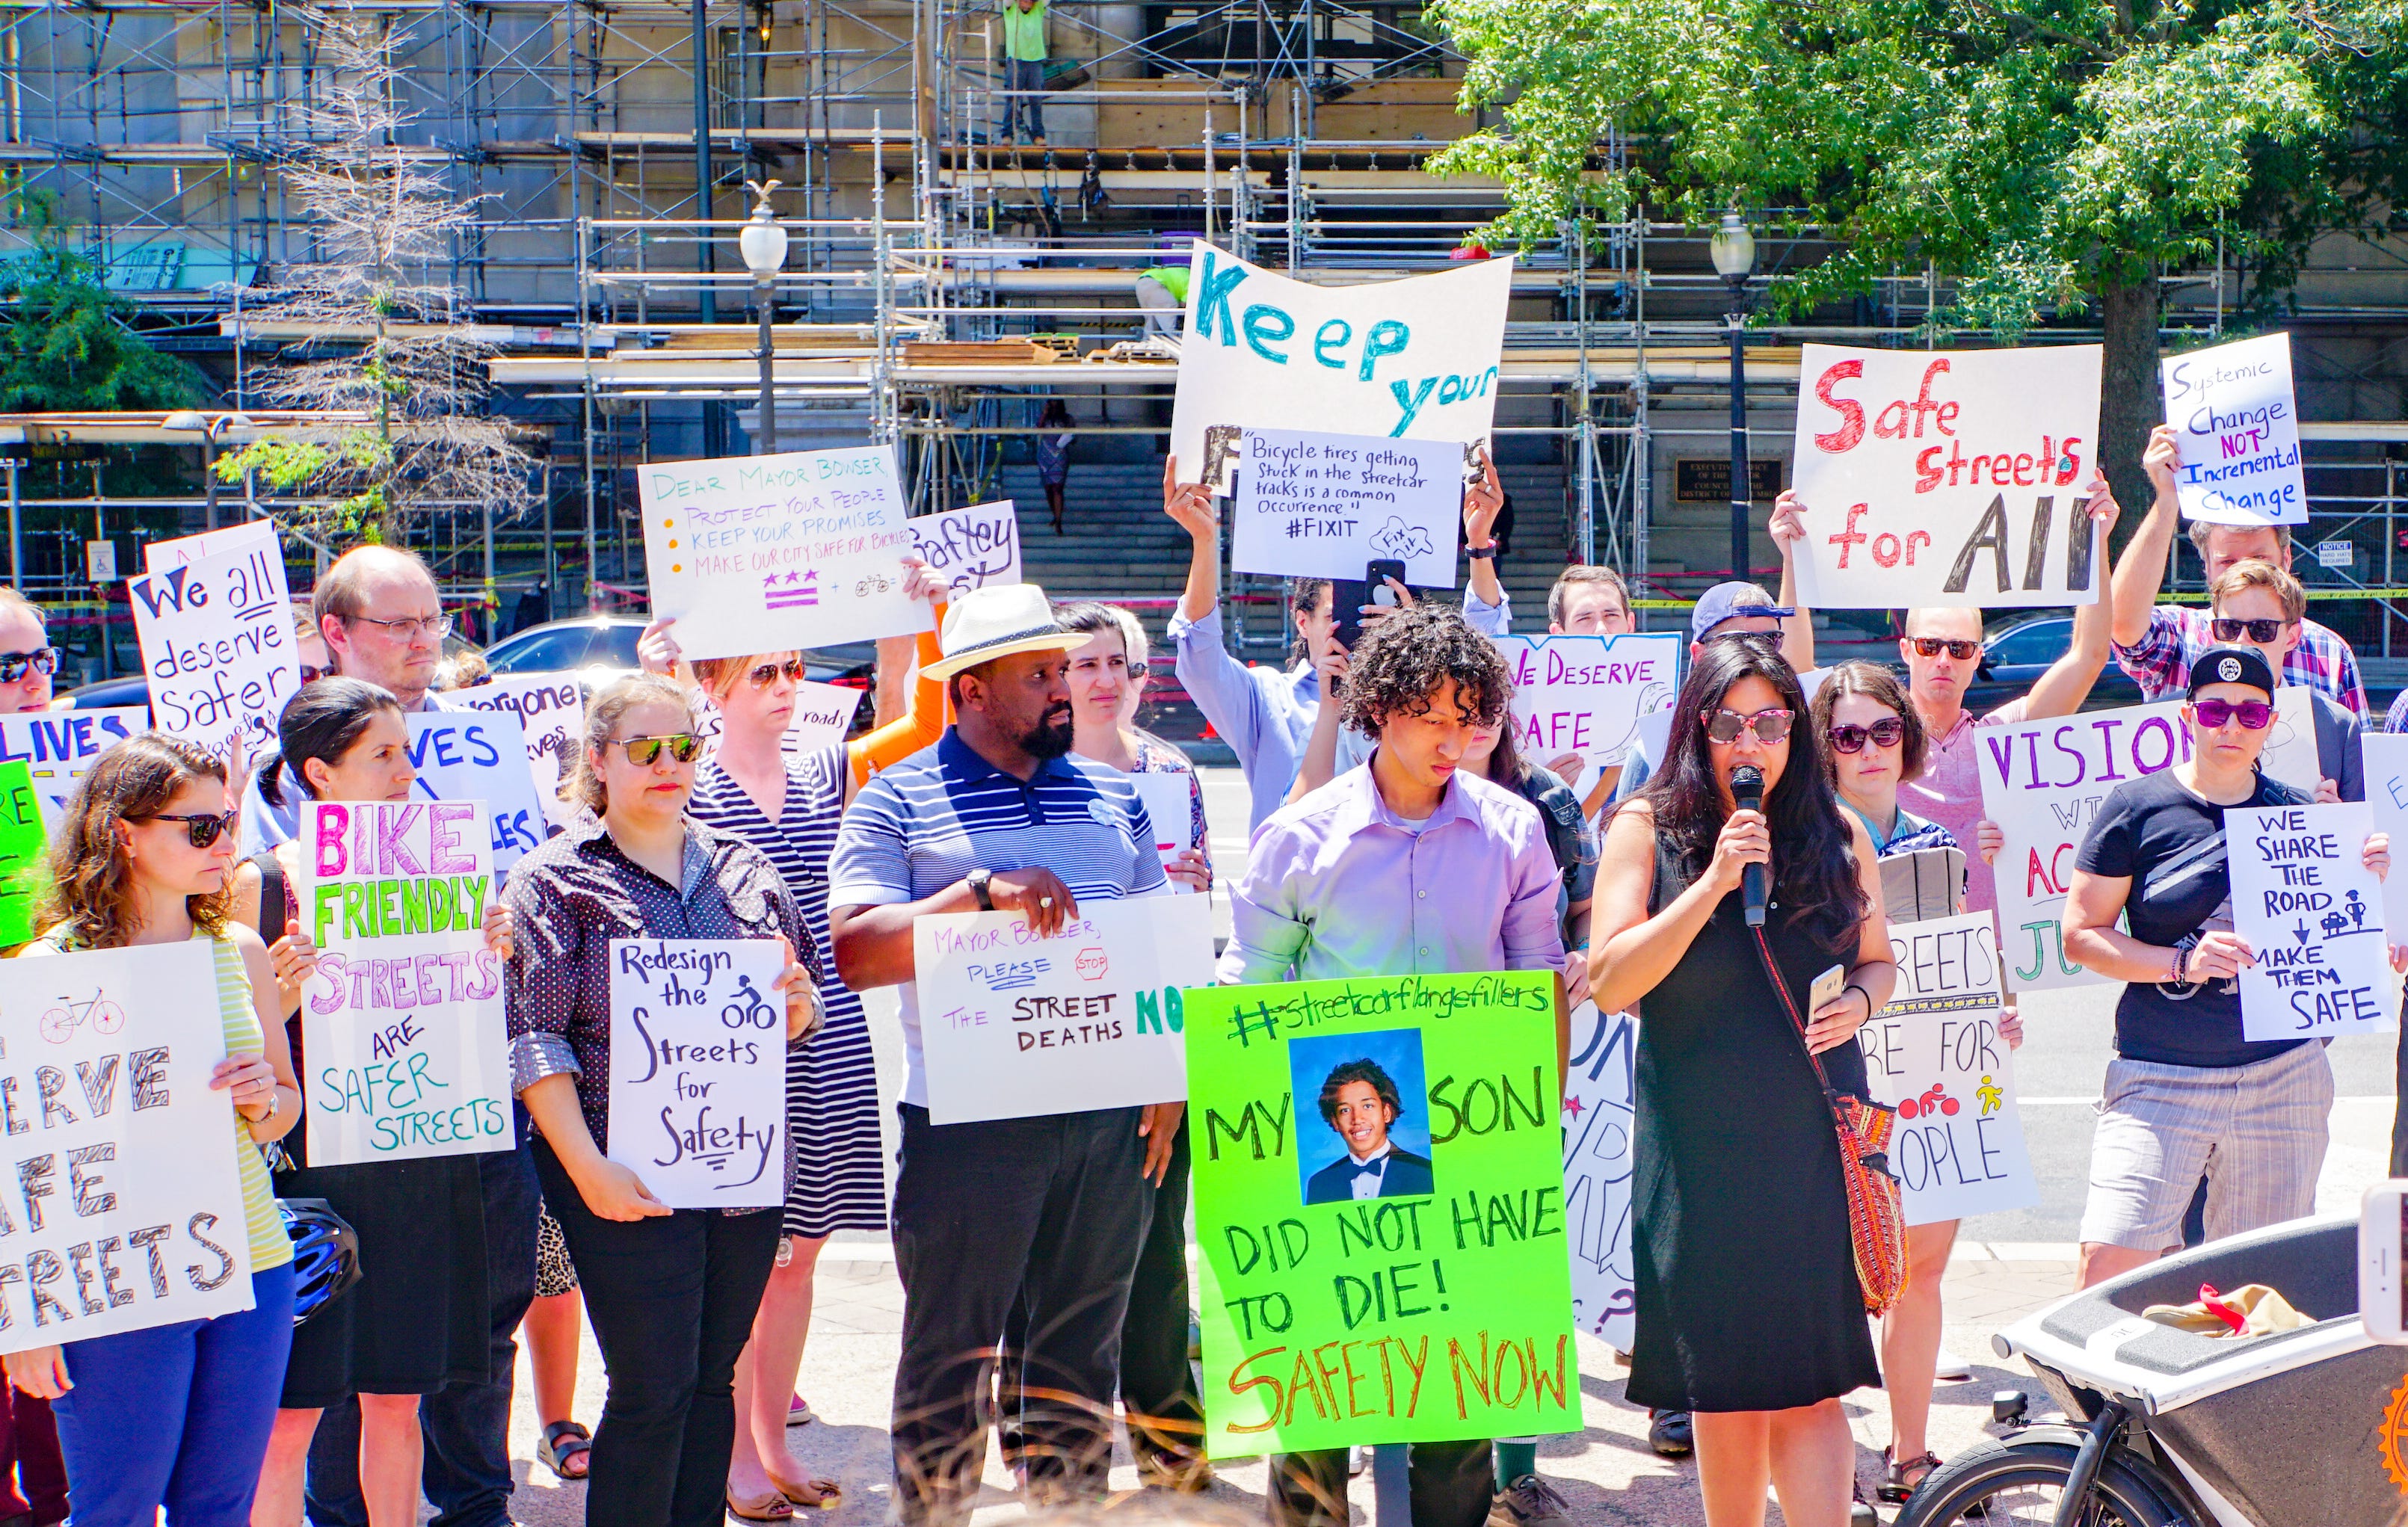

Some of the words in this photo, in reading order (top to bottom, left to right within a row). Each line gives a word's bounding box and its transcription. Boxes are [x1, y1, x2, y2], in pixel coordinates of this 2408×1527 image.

[1196, 251, 1411, 382] Keep
[1389, 365, 1499, 438] your
[2171, 361, 2273, 404] Systemic
[1814, 358, 1960, 454] Safe
[2187, 402, 2288, 439] Change
[1324, 445, 1358, 463] tires
[1366, 450, 1419, 479] getting
[2181, 442, 2300, 484] Incremental
[2220, 428, 2261, 460] NOT
[652, 474, 727, 501] DEAR
[739, 466, 810, 491] MAYOR
[1254, 480, 1298, 498] tracks
[1305, 482, 1316, 498] is
[1322, 487, 1329, 499] a
[1336, 488, 1396, 504] common
[1305, 466, 1318, 478] in
[1324, 463, 1352, 481] the
[683, 505, 777, 528] PROTECT
[783, 496, 825, 514] YOUR
[831, 488, 885, 509] PEOPLE
[1286, 518, 1358, 539] #FIXIT
[692, 527, 745, 550] KEEP
[752, 522, 795, 543] YOUR
[802, 510, 886, 536] PROMISES
[1382, 528, 1405, 548] Fix
[1402, 537, 1417, 552] it
[1829, 502, 1931, 570] for
[1943, 492, 2094, 593] All
[695, 555, 745, 578] MAKE
[752, 548, 780, 571] OUR
[783, 543, 810, 564] CITY
[814, 538, 844, 559] SAFE
[132, 565, 209, 620] We
[227, 550, 277, 608] all
[154, 624, 283, 679] deserve
[1547, 649, 1654, 685] DESERVE
[803, 709, 846, 729] roads
[315, 803, 476, 877] BIKE
[2258, 810, 2306, 832] WE
[2256, 833, 2340, 862] SHARE
[2270, 863, 2323, 886] THE
[314, 875, 490, 948] FRIENDLY
[2264, 890, 2333, 919] ROAD
[934, 927, 1009, 954] MAYOR
[310, 948, 499, 1015] STREETS
[620, 940, 732, 986] Redesign
[967, 958, 1052, 982] PLEASE
[1077, 956, 1106, 971] STOP
[2266, 968, 2341, 989] THEM
[659, 973, 707, 1007] the
[2290, 986, 2382, 1031] SAFE
[943, 1006, 989, 1031] THE
[1011, 993, 1117, 1022] STREET
[373, 1014, 425, 1061] ARE
[627, 1007, 760, 1084] Streets
[1017, 1020, 1122, 1052] DEATHS
[1940, 1020, 1999, 1072] FOR
[318, 1052, 449, 1117] SAFER
[673, 1071, 718, 1102] for
[370, 1098, 505, 1151] STREETS
[1206, 1092, 1291, 1162] MY
[1429, 1066, 1546, 1144] SON
[653, 1106, 775, 1190] Safety
[1224, 1218, 1309, 1276] DID
[1337, 1200, 1433, 1258] NOT
[1450, 1185, 1562, 1251] HAVE
[0, 1212, 236, 1333] TREETS
[1225, 1291, 1293, 1341] TO
[1334, 1259, 1450, 1331] DIE!
[1226, 1335, 1429, 1433] SAFETY
[1447, 1330, 1568, 1421] NOW
